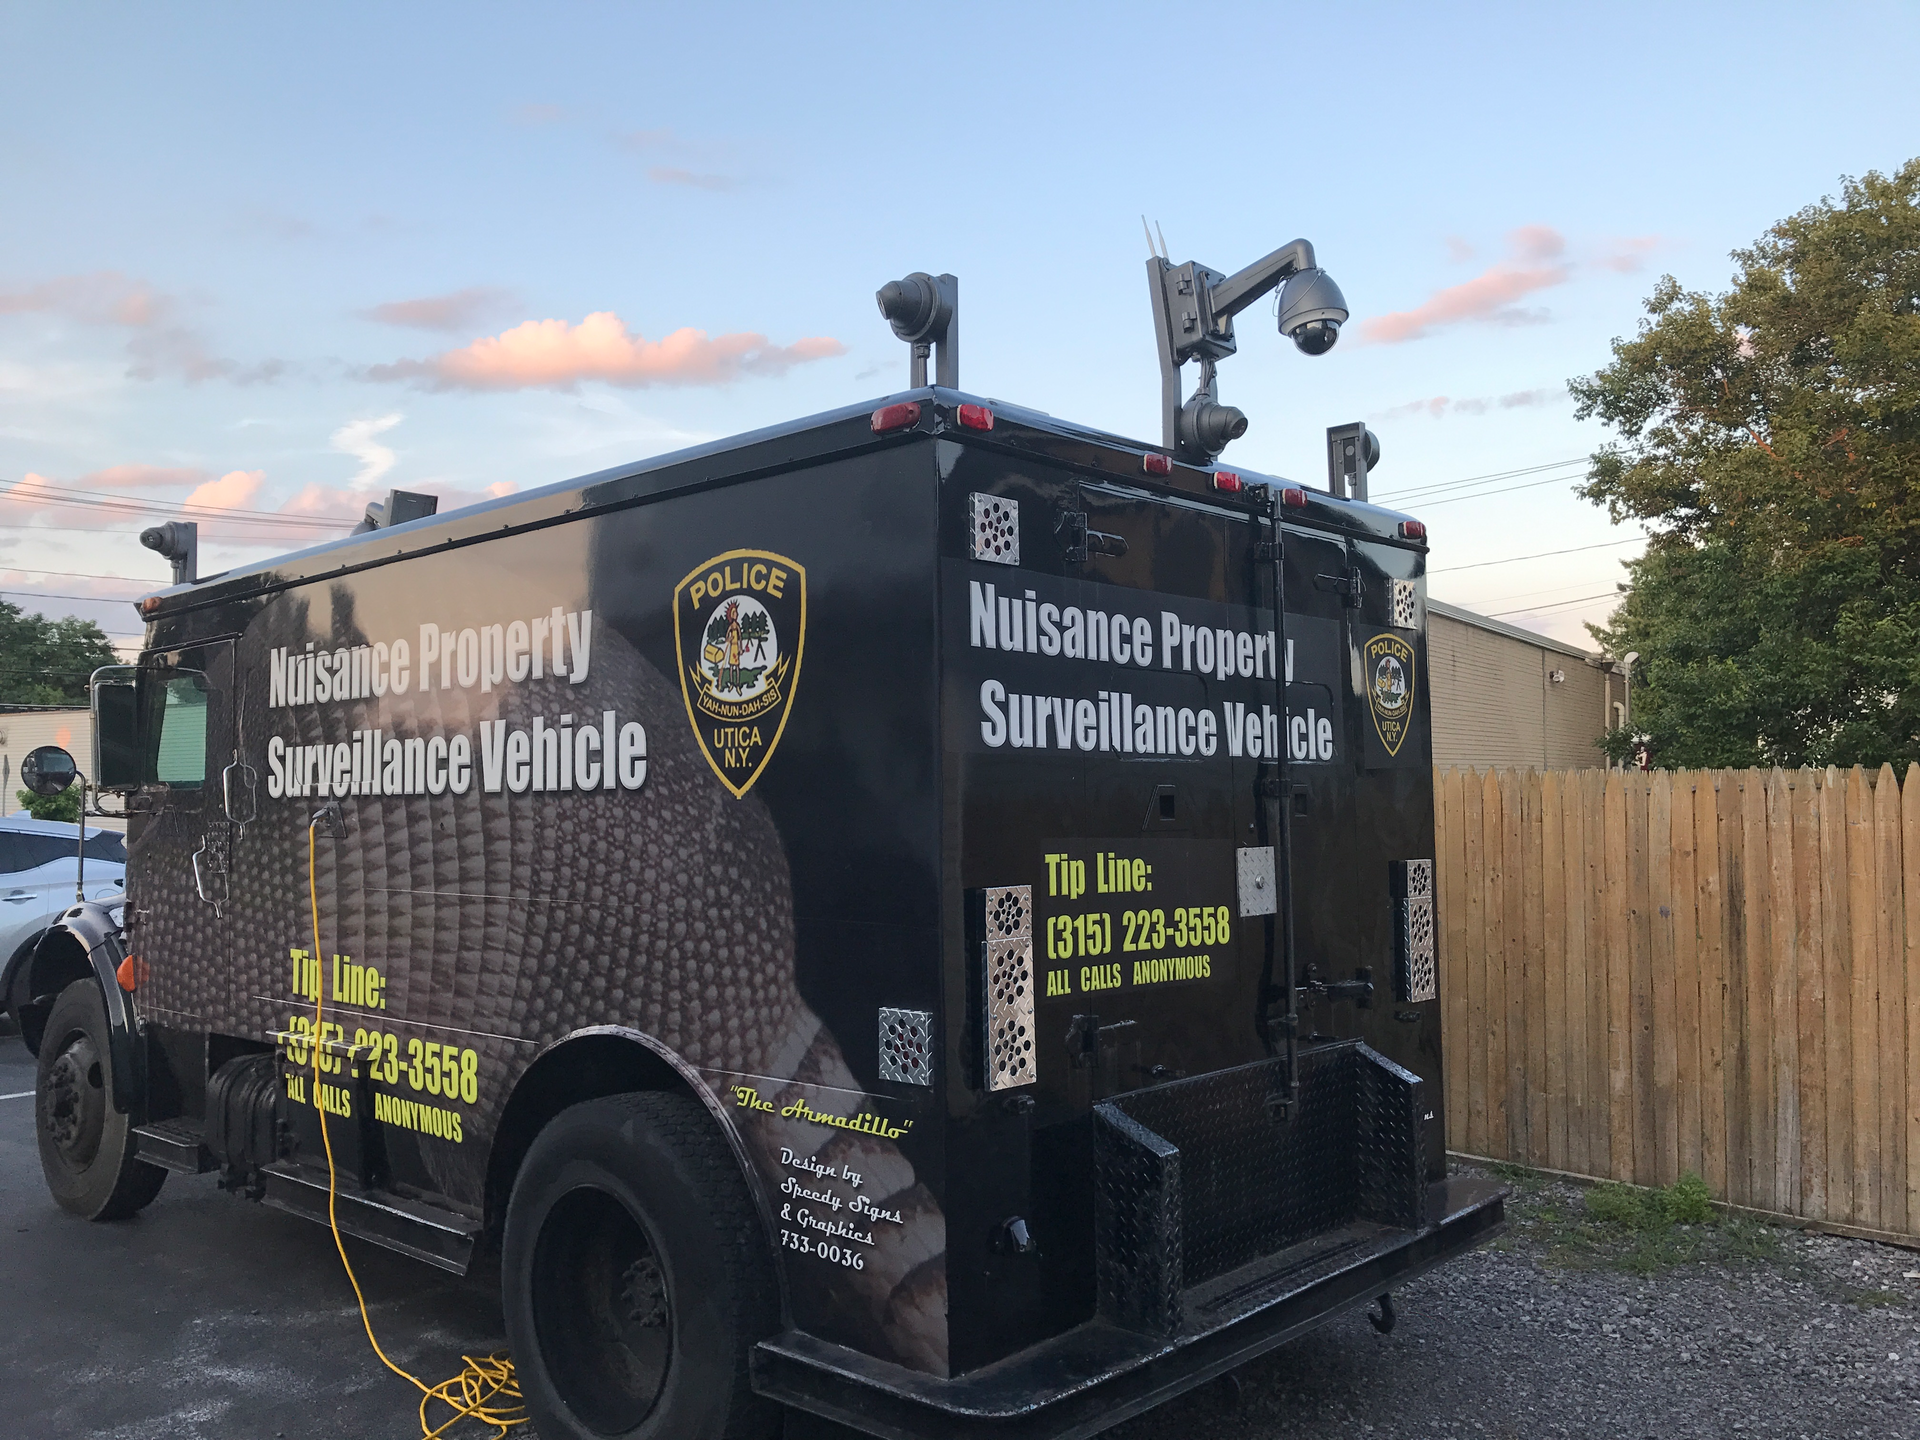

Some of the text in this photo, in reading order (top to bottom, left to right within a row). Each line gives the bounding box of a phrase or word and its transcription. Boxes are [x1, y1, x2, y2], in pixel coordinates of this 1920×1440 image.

[690, 563, 787, 610] POLICE
[269, 606, 593, 708] Nuisance Property
[969, 580, 1294, 687] Nuisance Property
[1370, 641, 1408, 663] POLICE
[702, 688, 777, 716] YAH-NUN-DAH-SIS
[979, 678, 1217, 757] Surveillance
[713, 726, 762, 748] UTICA
[1382, 721, 1401, 732] UTICA
[267, 710, 648, 798] Surveillance Vehicle
[724, 747, 752, 768] N.Y.
[1044, 852, 1152, 900] Tip Line:
[1046, 905, 1231, 960] (315) 223-3558
[290, 948, 386, 1010] Tip Line:
[1046, 954, 1211, 997] ALL CALLS ANONYMOUS
[285, 1073, 306, 1105] ALL
[374, 1092, 463, 1144] ANONYMOUS
[730, 1085, 913, 1139] "The Armadillo"
[780, 1147, 863, 1187] Design by
[780, 1177, 904, 1224] Speedy Signs
[780, 1203, 875, 1245] & Graphics
[780, 1229, 864, 1270] 733-0036
